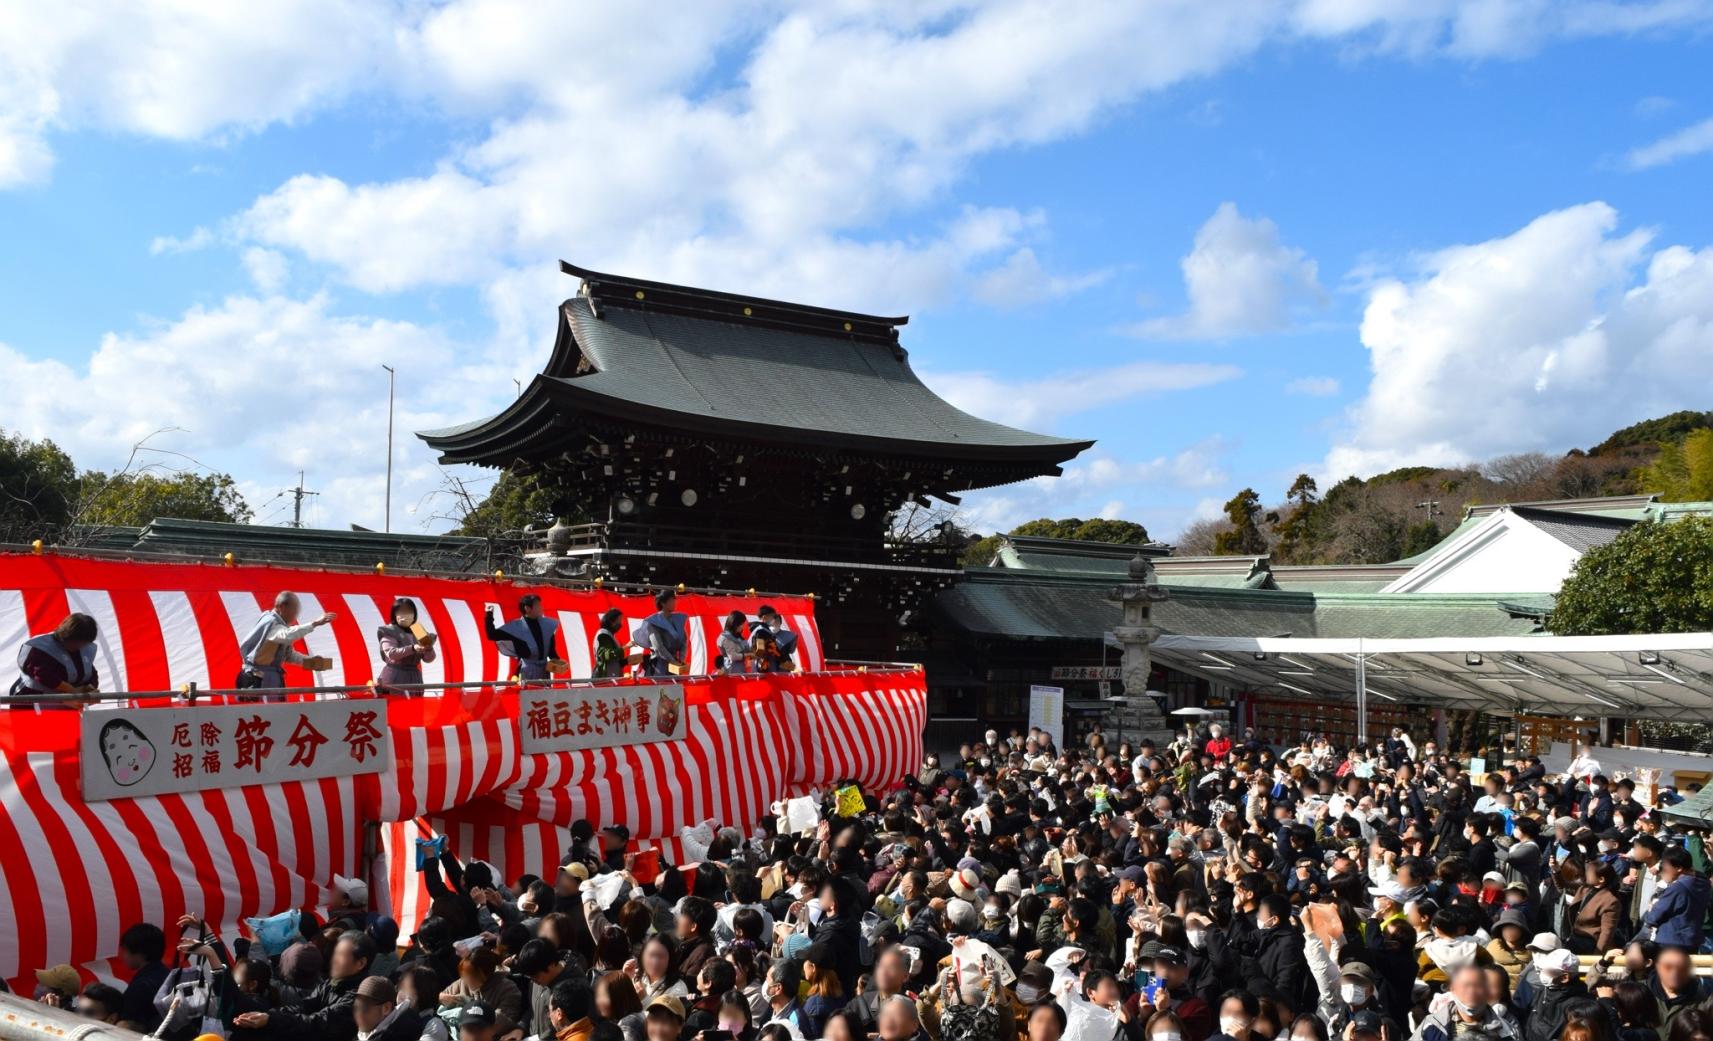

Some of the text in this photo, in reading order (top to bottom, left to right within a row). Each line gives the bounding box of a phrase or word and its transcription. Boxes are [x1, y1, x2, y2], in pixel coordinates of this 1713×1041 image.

[171, 721, 222, 748] 厄除
[527, 697, 651, 740] 福豆まき神事
[233, 710, 383, 773] 節分祭
[172, 750, 221, 778] 招福
